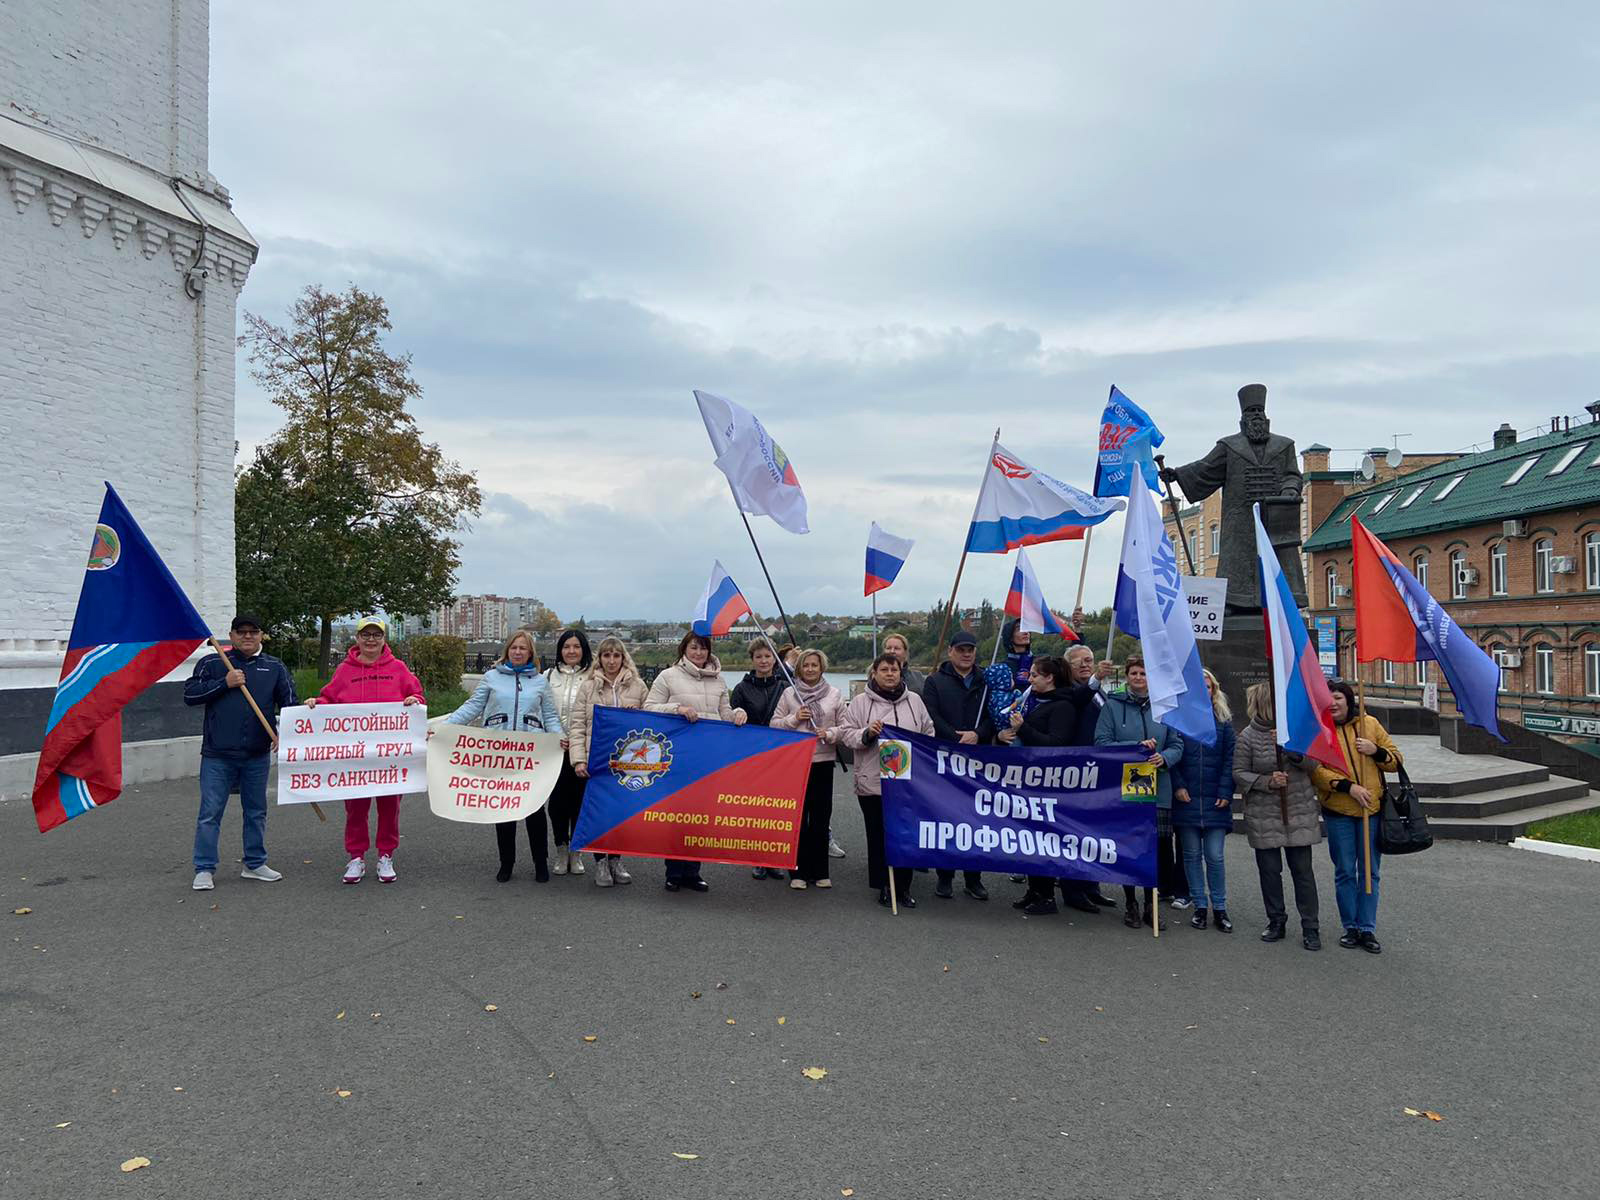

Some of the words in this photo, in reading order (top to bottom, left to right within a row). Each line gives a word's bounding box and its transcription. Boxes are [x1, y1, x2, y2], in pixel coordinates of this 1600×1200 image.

[1208, 612, 1217, 621] О
[295, 719, 314, 734] ЗА
[323, 712, 409, 733] ДОСТОЙНЫЙ
[287, 748, 297, 762] И
[304, 741, 366, 761] МИРНЫЙ
[376, 743, 412, 757] ТРУД
[455, 735, 534, 752] ДОСТОЙНАЯ
[936, 750, 1099, 789] ГОРОДСКОЙ
[290, 773, 321, 789] БЕЗ
[448, 776, 530, 791] ДОСТОЙНАЯ
[456, 793, 521, 809] ПЕНСИЯ
[717, 793, 797, 810] РОССИЙСКИЙ
[974, 789, 1058, 823] СОВЕТ
[643, 811, 709, 825] ПРОФСОЮЗ
[714, 815, 793, 831] РАБОТНИКОВ
[684, 836, 791, 854] ПРОМЫШЛЕННОСТИ
[918, 821, 1118, 864] ПРОФСОЮЗОВ
